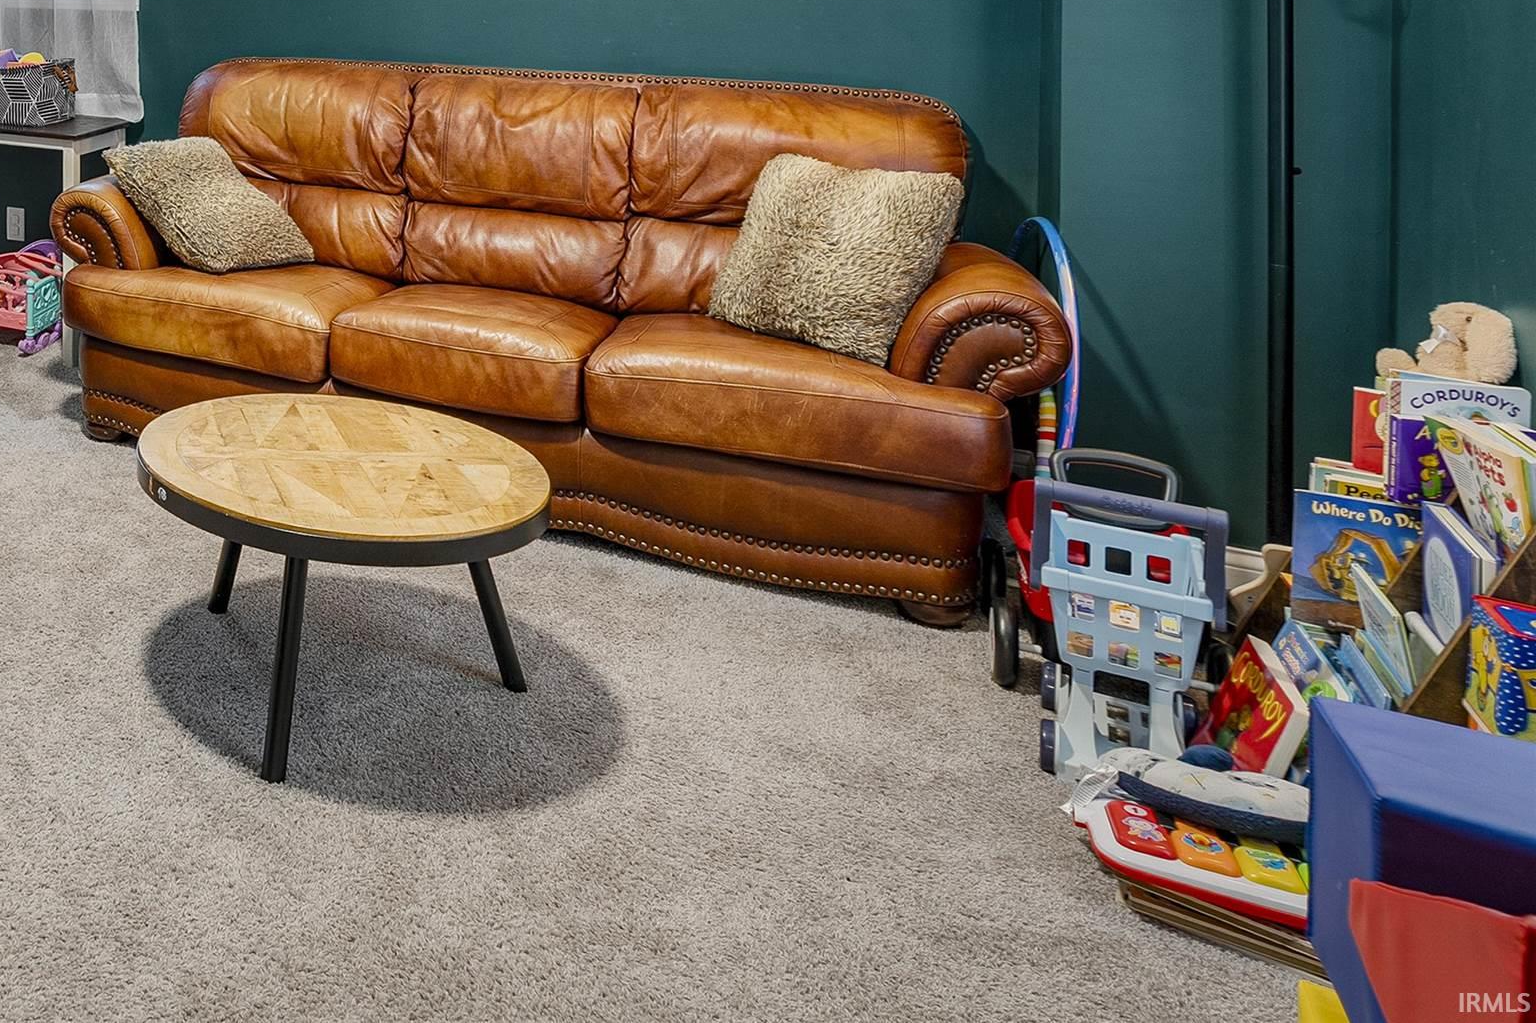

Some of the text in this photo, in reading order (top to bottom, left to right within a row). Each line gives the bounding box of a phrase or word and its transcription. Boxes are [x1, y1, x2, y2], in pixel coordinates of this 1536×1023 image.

[1409, 388, 1521, 418] CORDUROY'S
[1414, 425, 1432, 440] A
[1311, 500, 1366, 522] Where
[1368, 508, 1392, 526] Do
